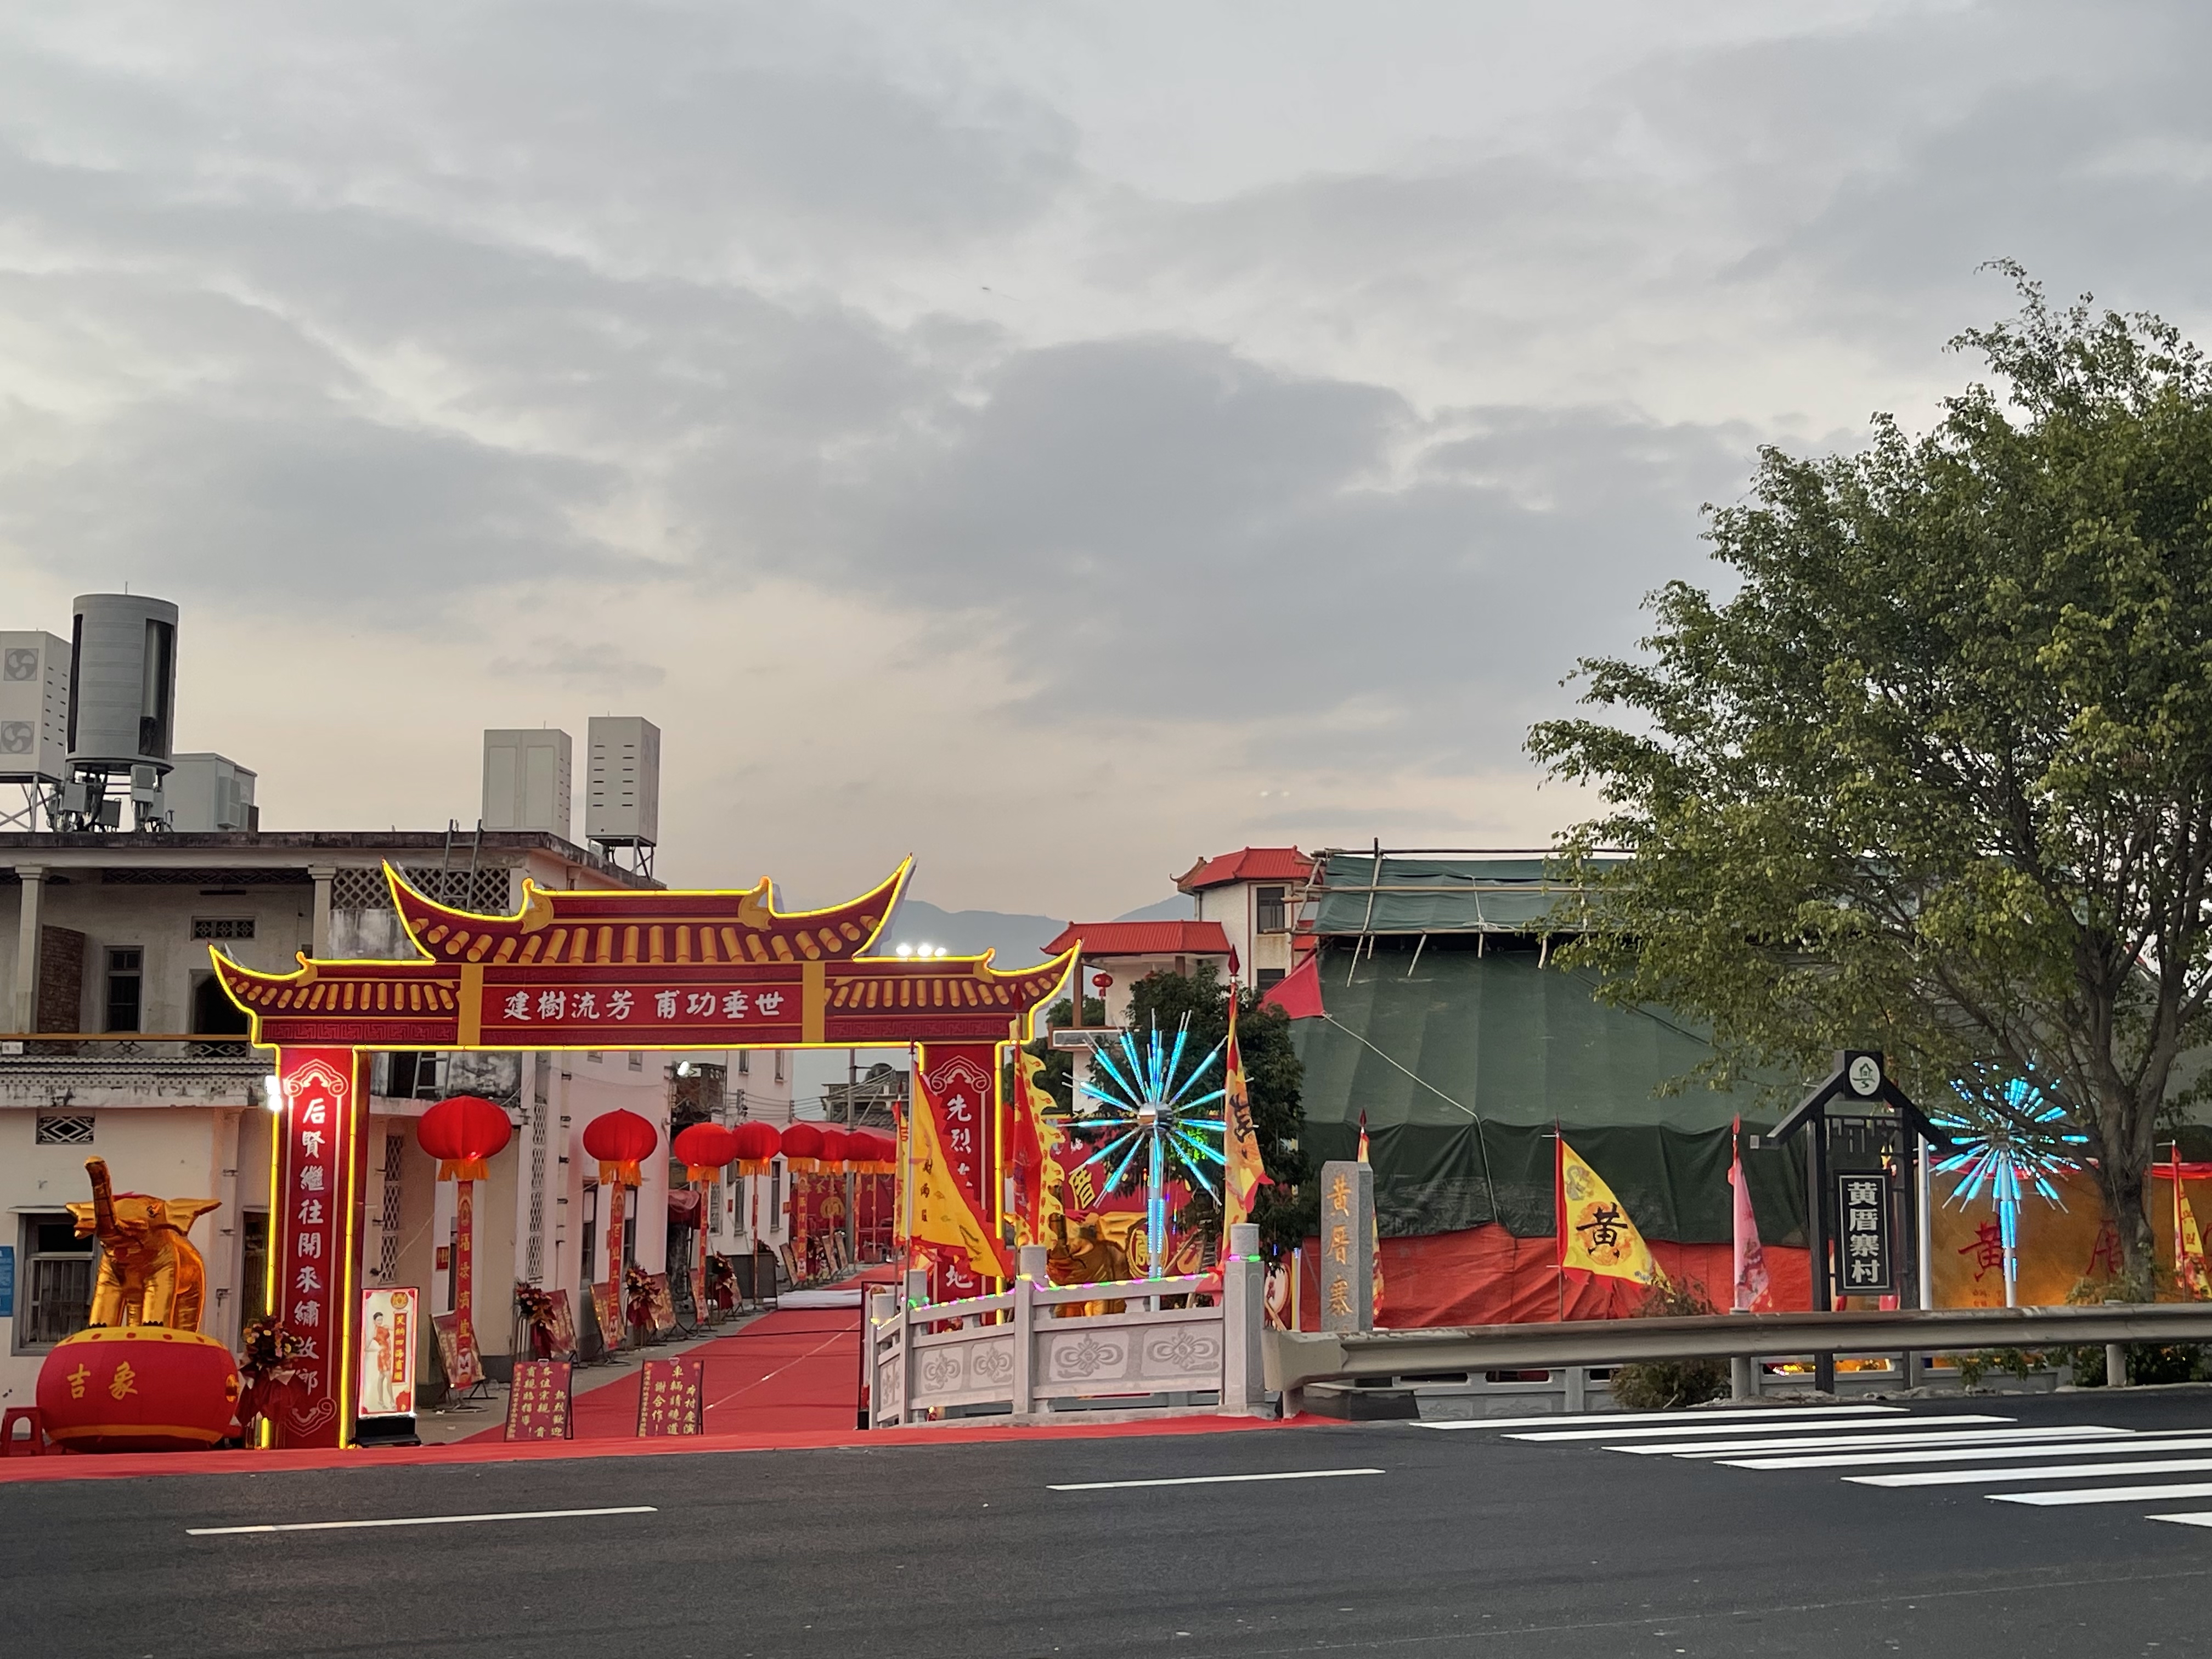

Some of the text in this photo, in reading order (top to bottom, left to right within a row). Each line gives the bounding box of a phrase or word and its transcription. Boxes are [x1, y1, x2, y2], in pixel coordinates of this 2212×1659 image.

[503, 990, 784, 1020] 建樹流芳 甫功垂世
[1327, 1173, 1353, 1331] 黄厝寨
[1576, 1201, 1628, 1258] 黄
[1848, 1182, 1880, 1283] 黄厝寨村
[66, 1361, 138, 1400] 吉象
